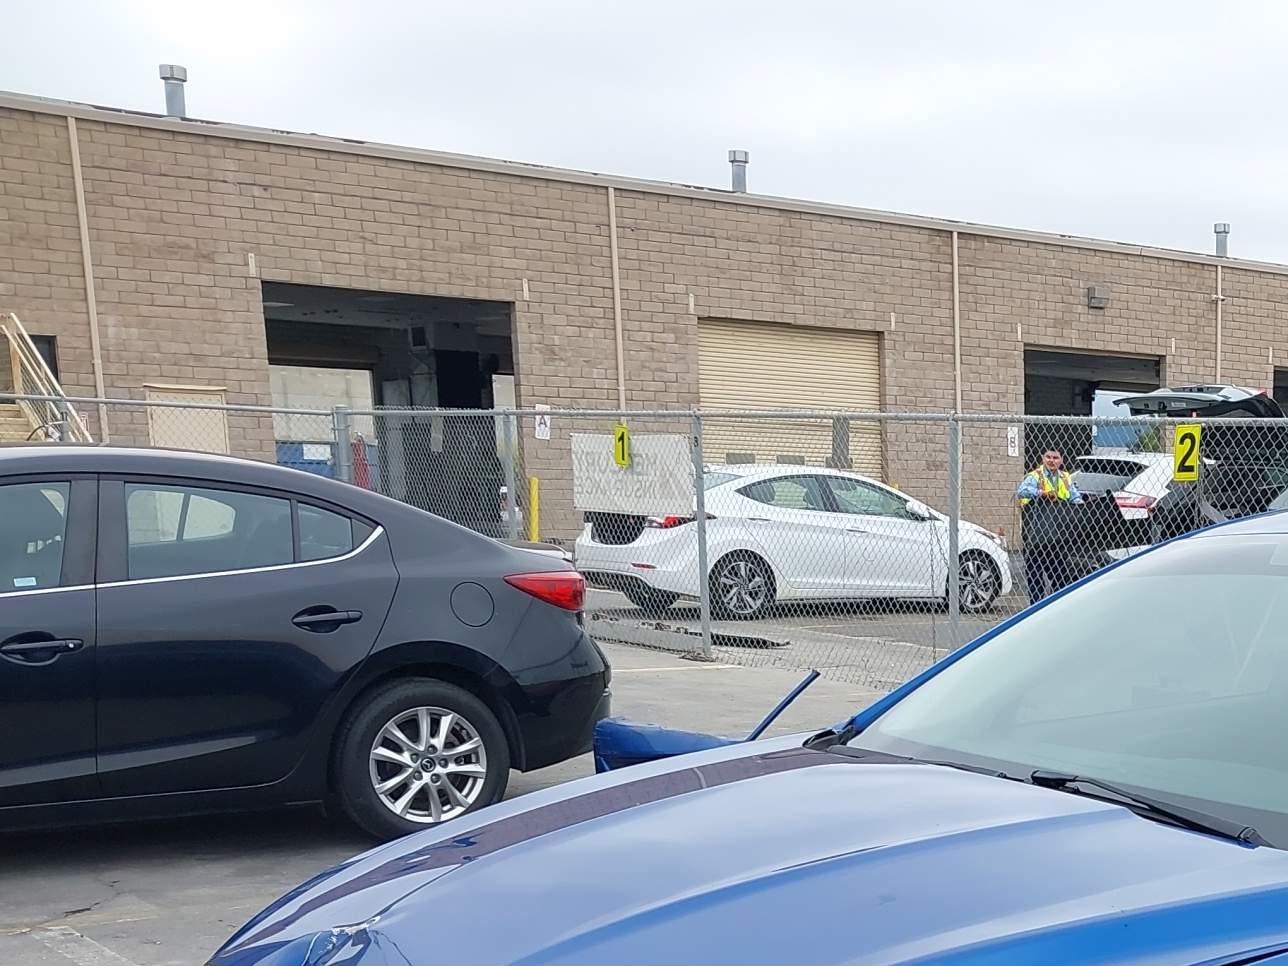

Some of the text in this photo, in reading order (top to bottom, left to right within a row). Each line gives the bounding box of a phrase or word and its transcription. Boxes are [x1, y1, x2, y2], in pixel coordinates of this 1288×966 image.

[538, 415, 548, 428] A
[617, 431, 626, 461] 1
[1177, 431, 1197, 473] 2
